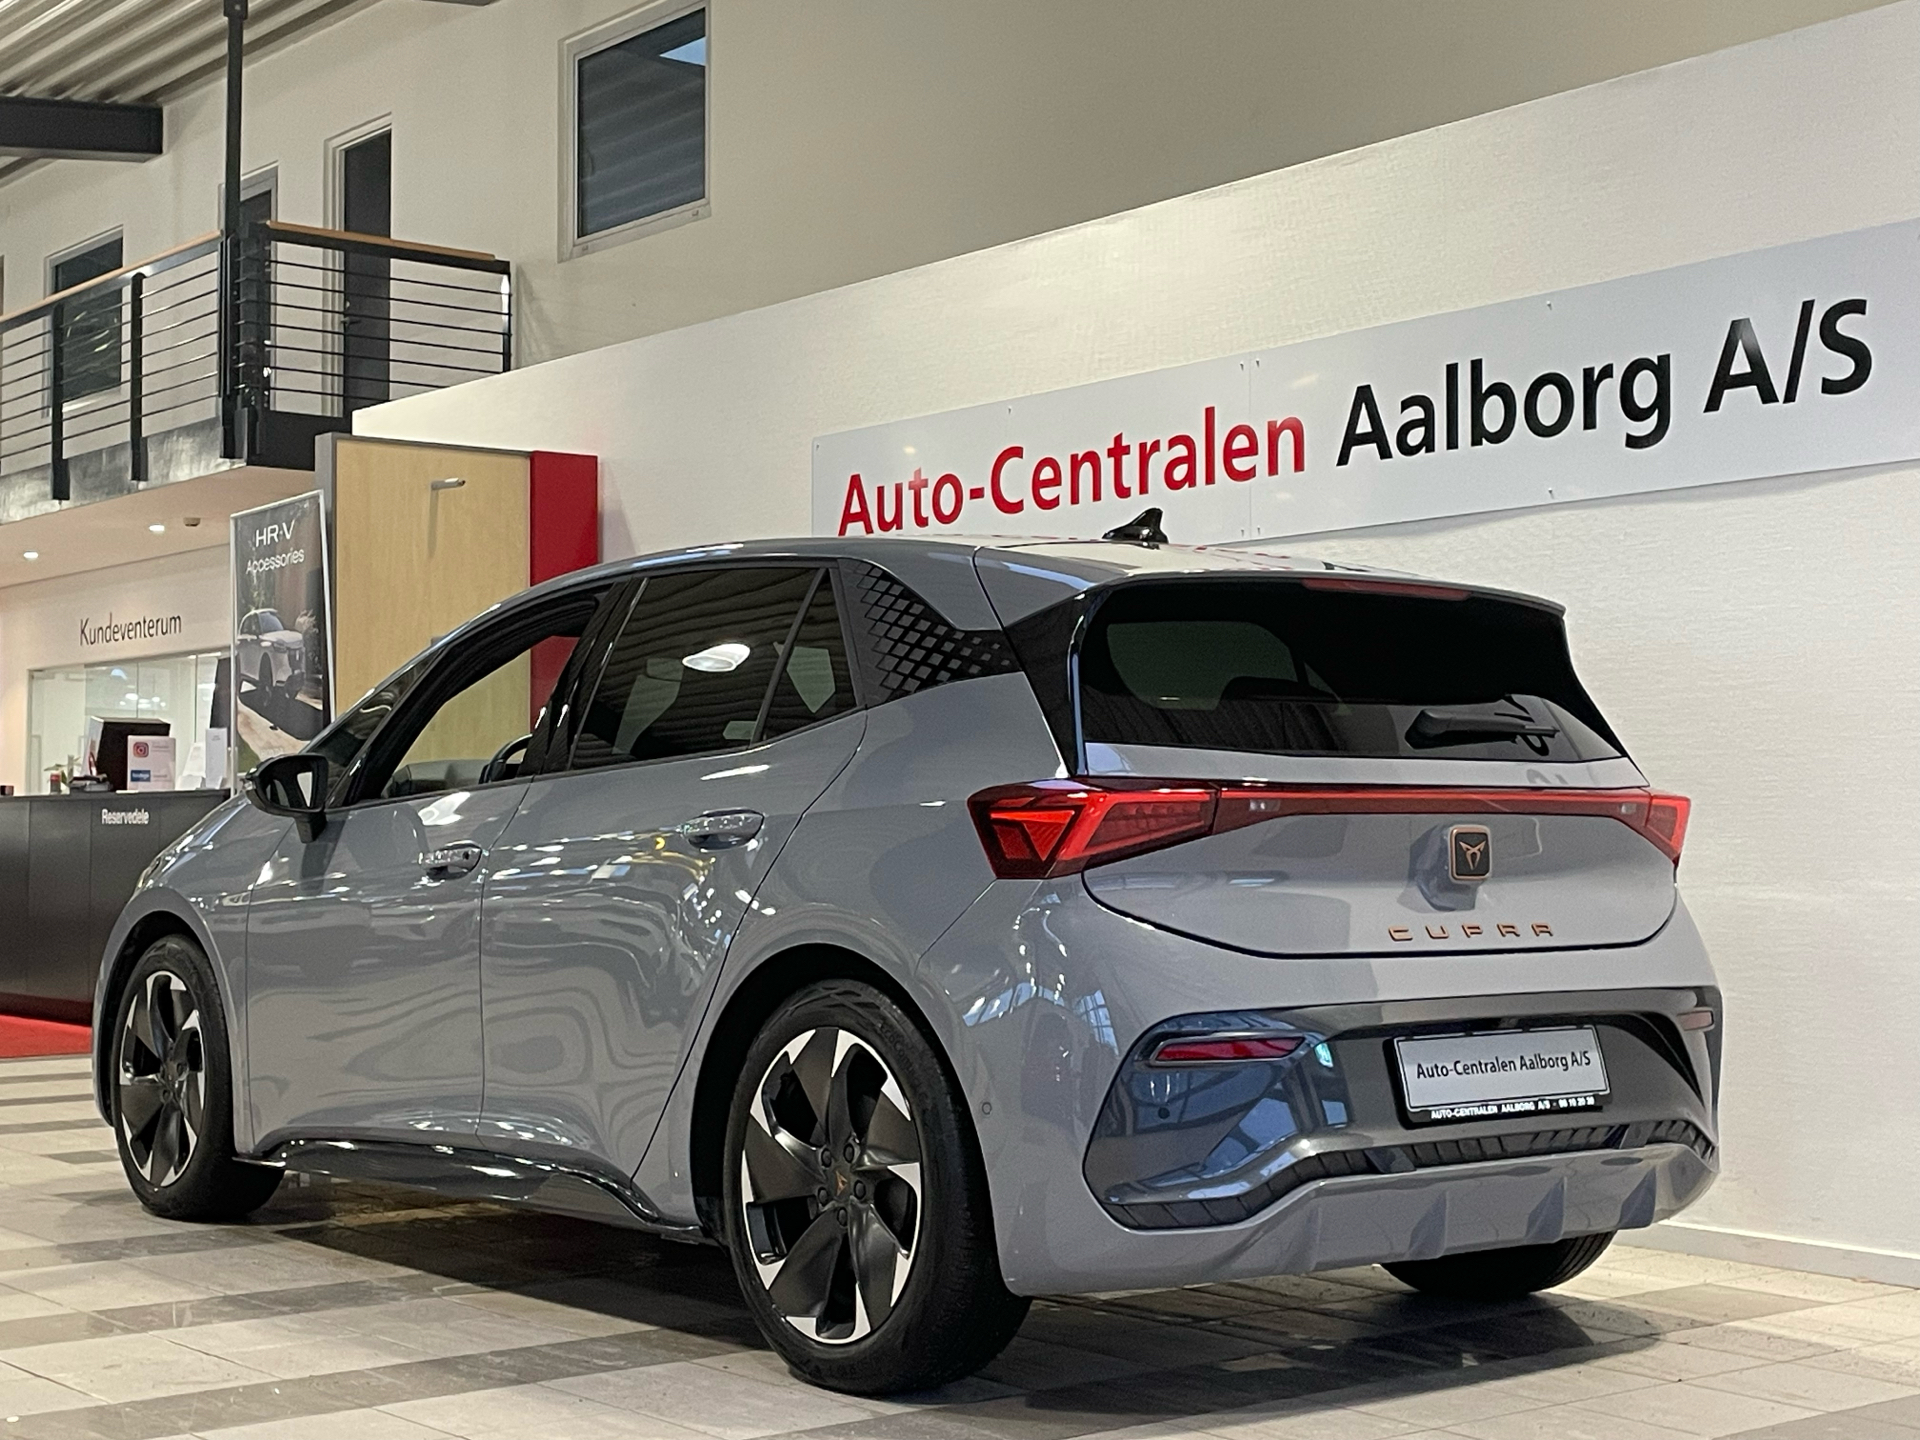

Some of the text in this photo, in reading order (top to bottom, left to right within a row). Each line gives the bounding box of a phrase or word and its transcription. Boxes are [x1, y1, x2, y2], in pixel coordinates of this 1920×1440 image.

[838, 298, 1873, 537] Auto-Centralen Aalborg A/S
[245, 547, 305, 575] Accessories
[79, 611, 182, 647] Kundeventerum
[101, 808, 150, 825] Reservedele
[1388, 922, 1554, 942] CUPRA
[1416, 1050, 1592, 1080] Auto-Centralen Aalborg A/S
[1430, 1105, 1498, 1120] AUTO-CENTRALEN
[1500, 1101, 1536, 1114] AALBORG
